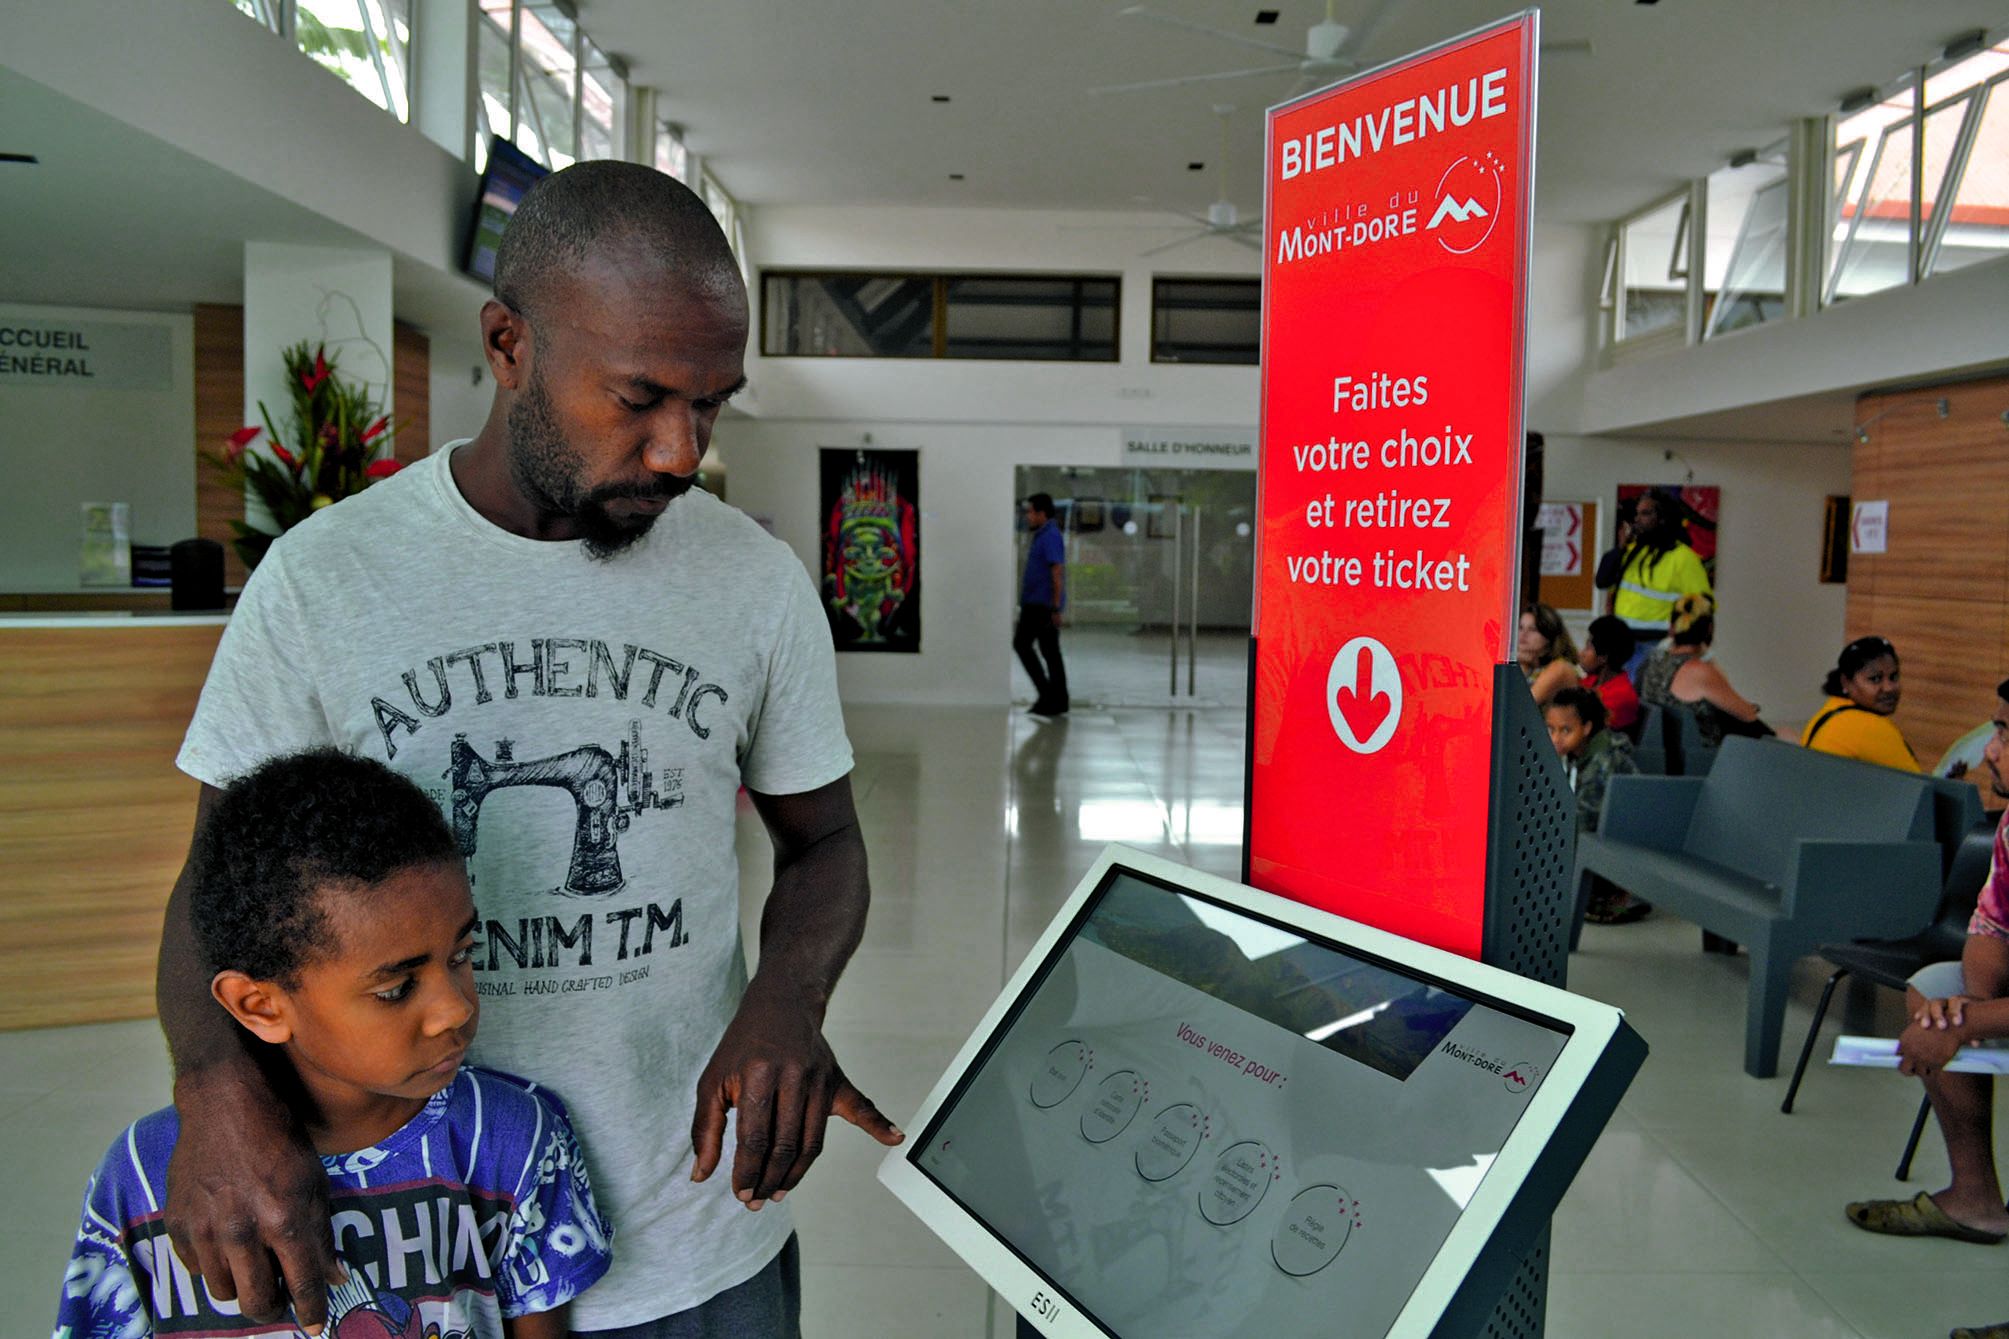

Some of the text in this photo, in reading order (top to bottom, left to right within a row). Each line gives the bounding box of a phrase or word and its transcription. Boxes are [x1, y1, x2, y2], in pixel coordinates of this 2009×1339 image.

[1281, 68, 1508, 180] BIENVENUE
[1306, 190, 1419, 229] ville du
[1277, 209, 1418, 264] MONT-DORE
[0, 327, 90, 350] CCUEIL
[0, 351, 95, 377] ÉNÉRAL
[1333, 372, 1428, 413] Faites
[1127, 441, 1252, 455] SALLE D'HONNEUR
[1293, 425, 1474, 472] votre choix
[1306, 489, 1451, 528] et retirez
[1287, 550, 1471, 592] votre ticket
[371, 638, 728, 760] AUTHENTIC
[472, 897, 689, 971] NIM T.M.
[474, 981, 516, 996] RIGINAL
[523, 980, 559, 995] HAND
[561, 976, 613, 992] CRAFTED
[1175, 1021, 1206, 1050] Vous
[1206, 1039, 1244, 1068] venez
[1242, 1059, 1281, 1087] pour
[1441, 1041, 1503, 1075] MONT-DORE
[133, 1197, 508, 1319] MCHINO
